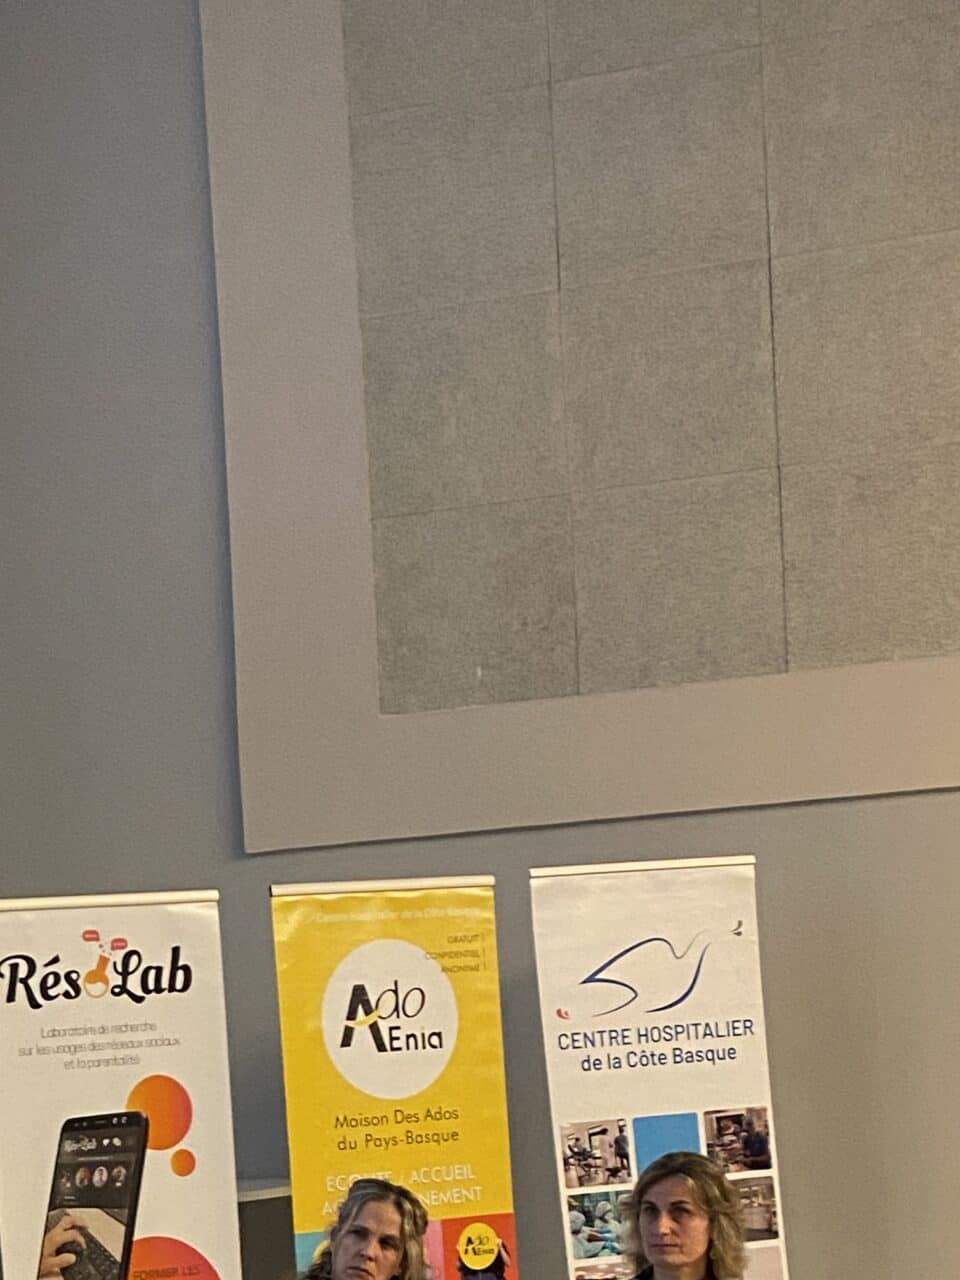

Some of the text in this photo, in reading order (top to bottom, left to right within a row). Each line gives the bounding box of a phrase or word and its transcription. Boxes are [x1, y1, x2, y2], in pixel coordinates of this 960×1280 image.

[110, 945, 193, 1004] Lab
[557, 1018, 755, 1050] CENTRE HOSPITALIER
[581, 1045, 737, 1071] de la Côte Basque
[334, 1106, 460, 1130] Maison Des Ados
[337, 1129, 460, 1151] du Pays-Basque
[408, 1163, 477, 1184] ACCUEIL
